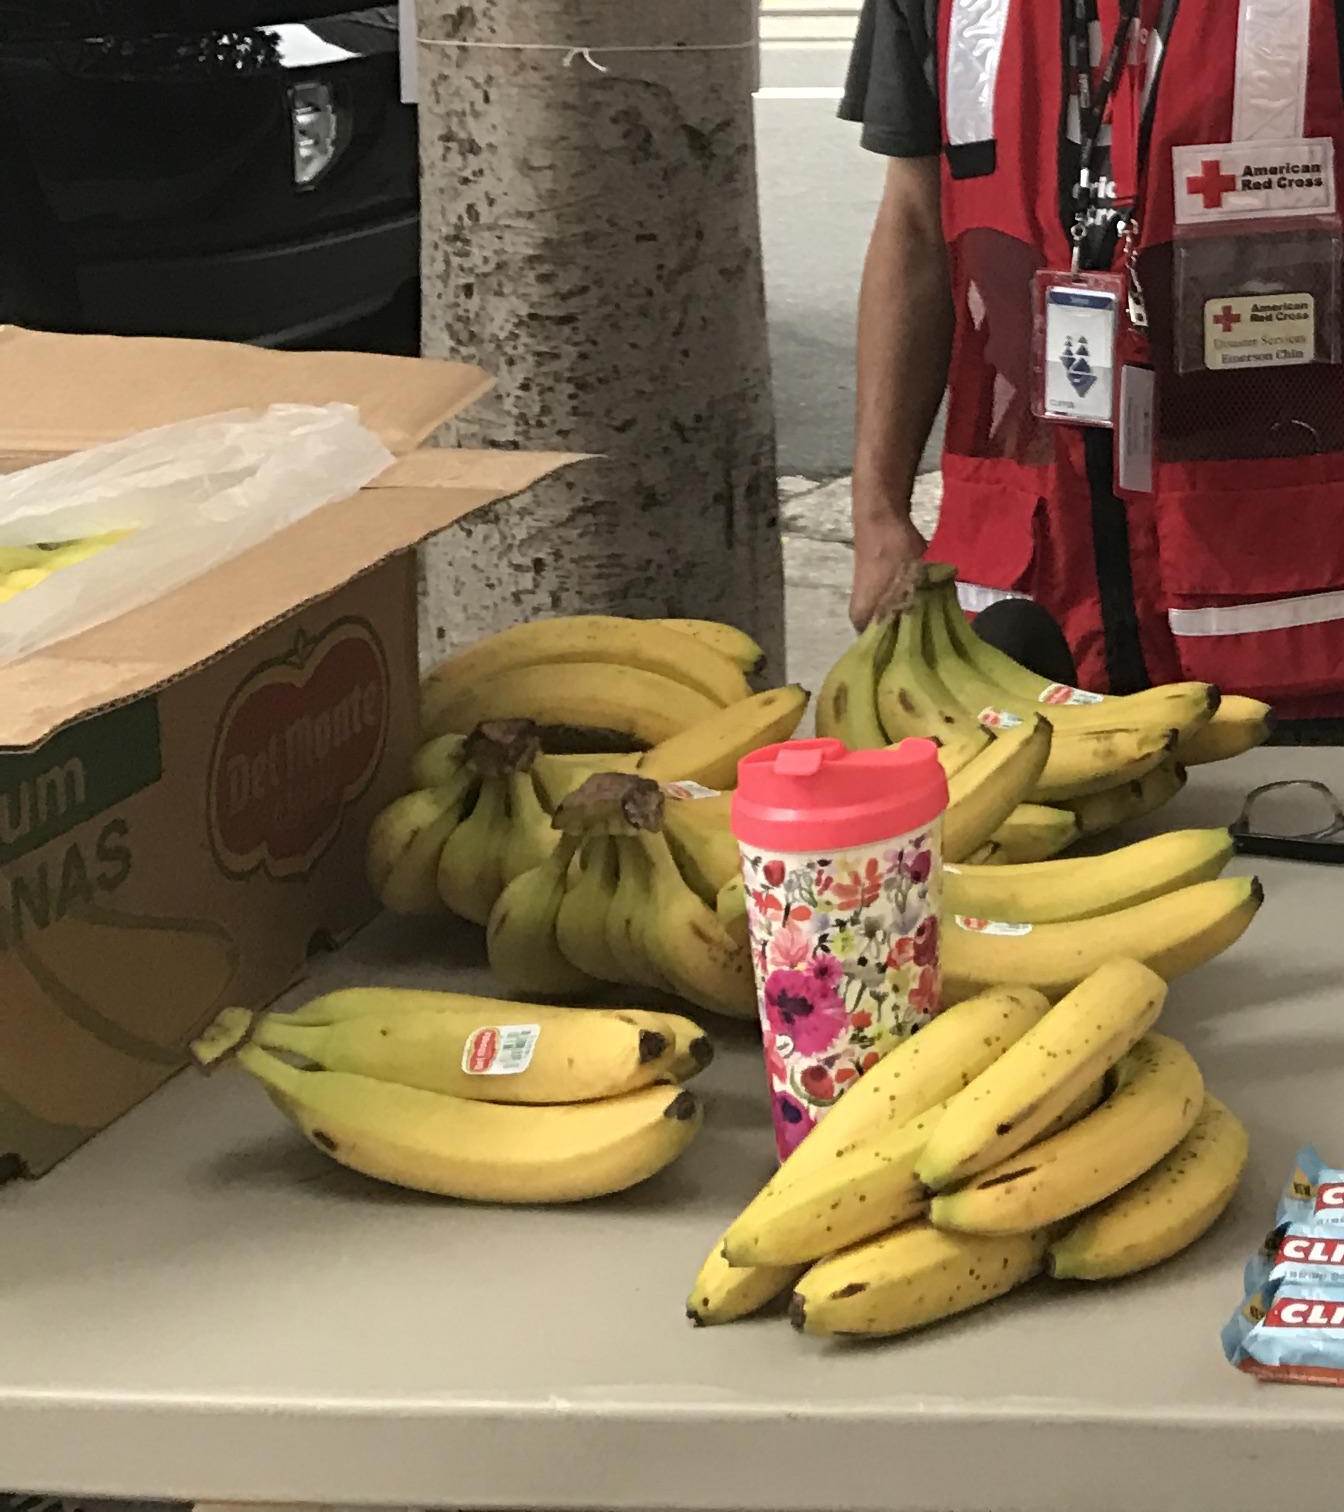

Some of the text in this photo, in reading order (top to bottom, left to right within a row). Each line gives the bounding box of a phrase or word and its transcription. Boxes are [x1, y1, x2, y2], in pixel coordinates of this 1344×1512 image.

[1242, 163, 1321, 177] American
[1241, 176, 1323, 191] Red Cross
[1251, 303, 1309, 313] American
[1250, 312, 1310, 322] Red Cross
[1221, 353, 1273, 364] Emerson
